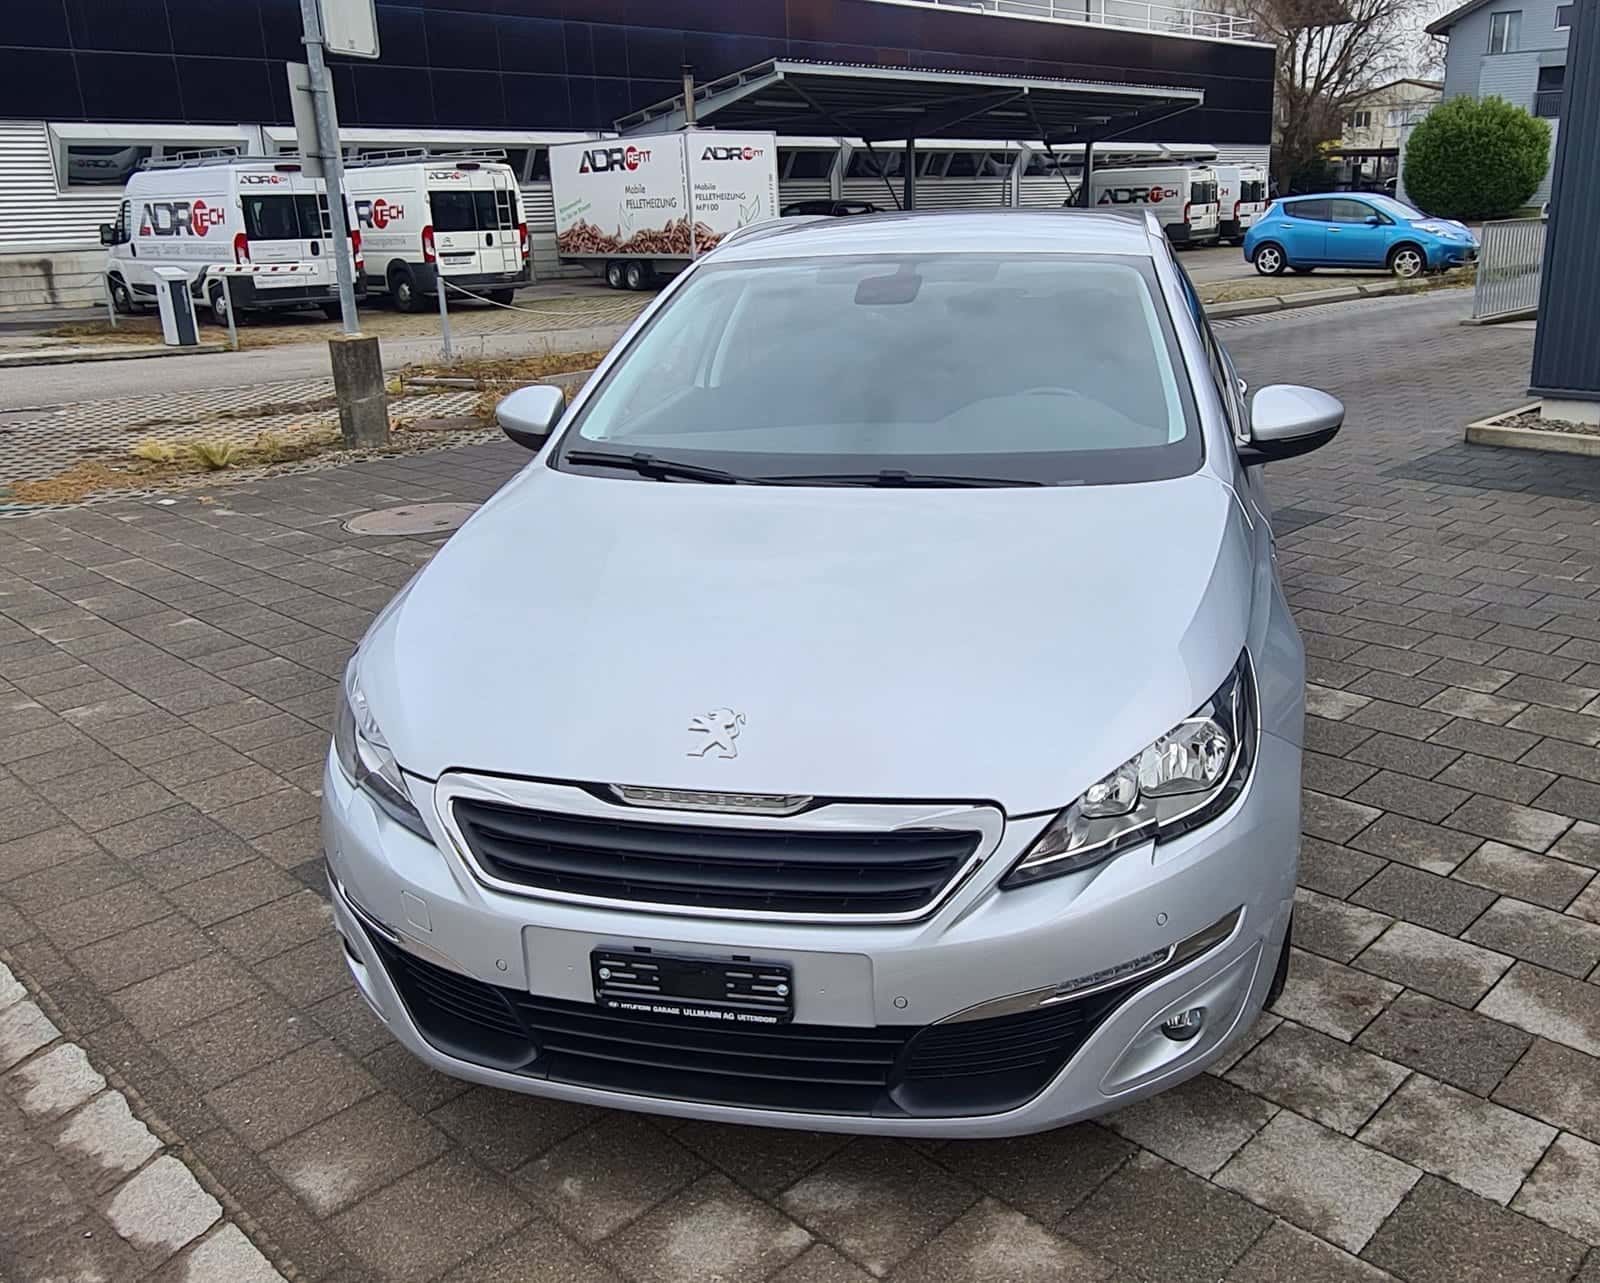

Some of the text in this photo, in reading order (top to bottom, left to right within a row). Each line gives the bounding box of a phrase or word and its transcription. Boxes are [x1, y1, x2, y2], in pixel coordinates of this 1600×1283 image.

[625, 184, 646, 194] Mobile
[694, 183, 717, 191] Mobile
[695, 192, 746, 201] PELLETHEIZUNG
[626, 197, 678, 209] PELLETHEIZUNG
[652, 1006, 681, 1014] GARAGE
[683, 1008, 722, 1019] ULLMANN
[722, 1012, 735, 1020] AG
